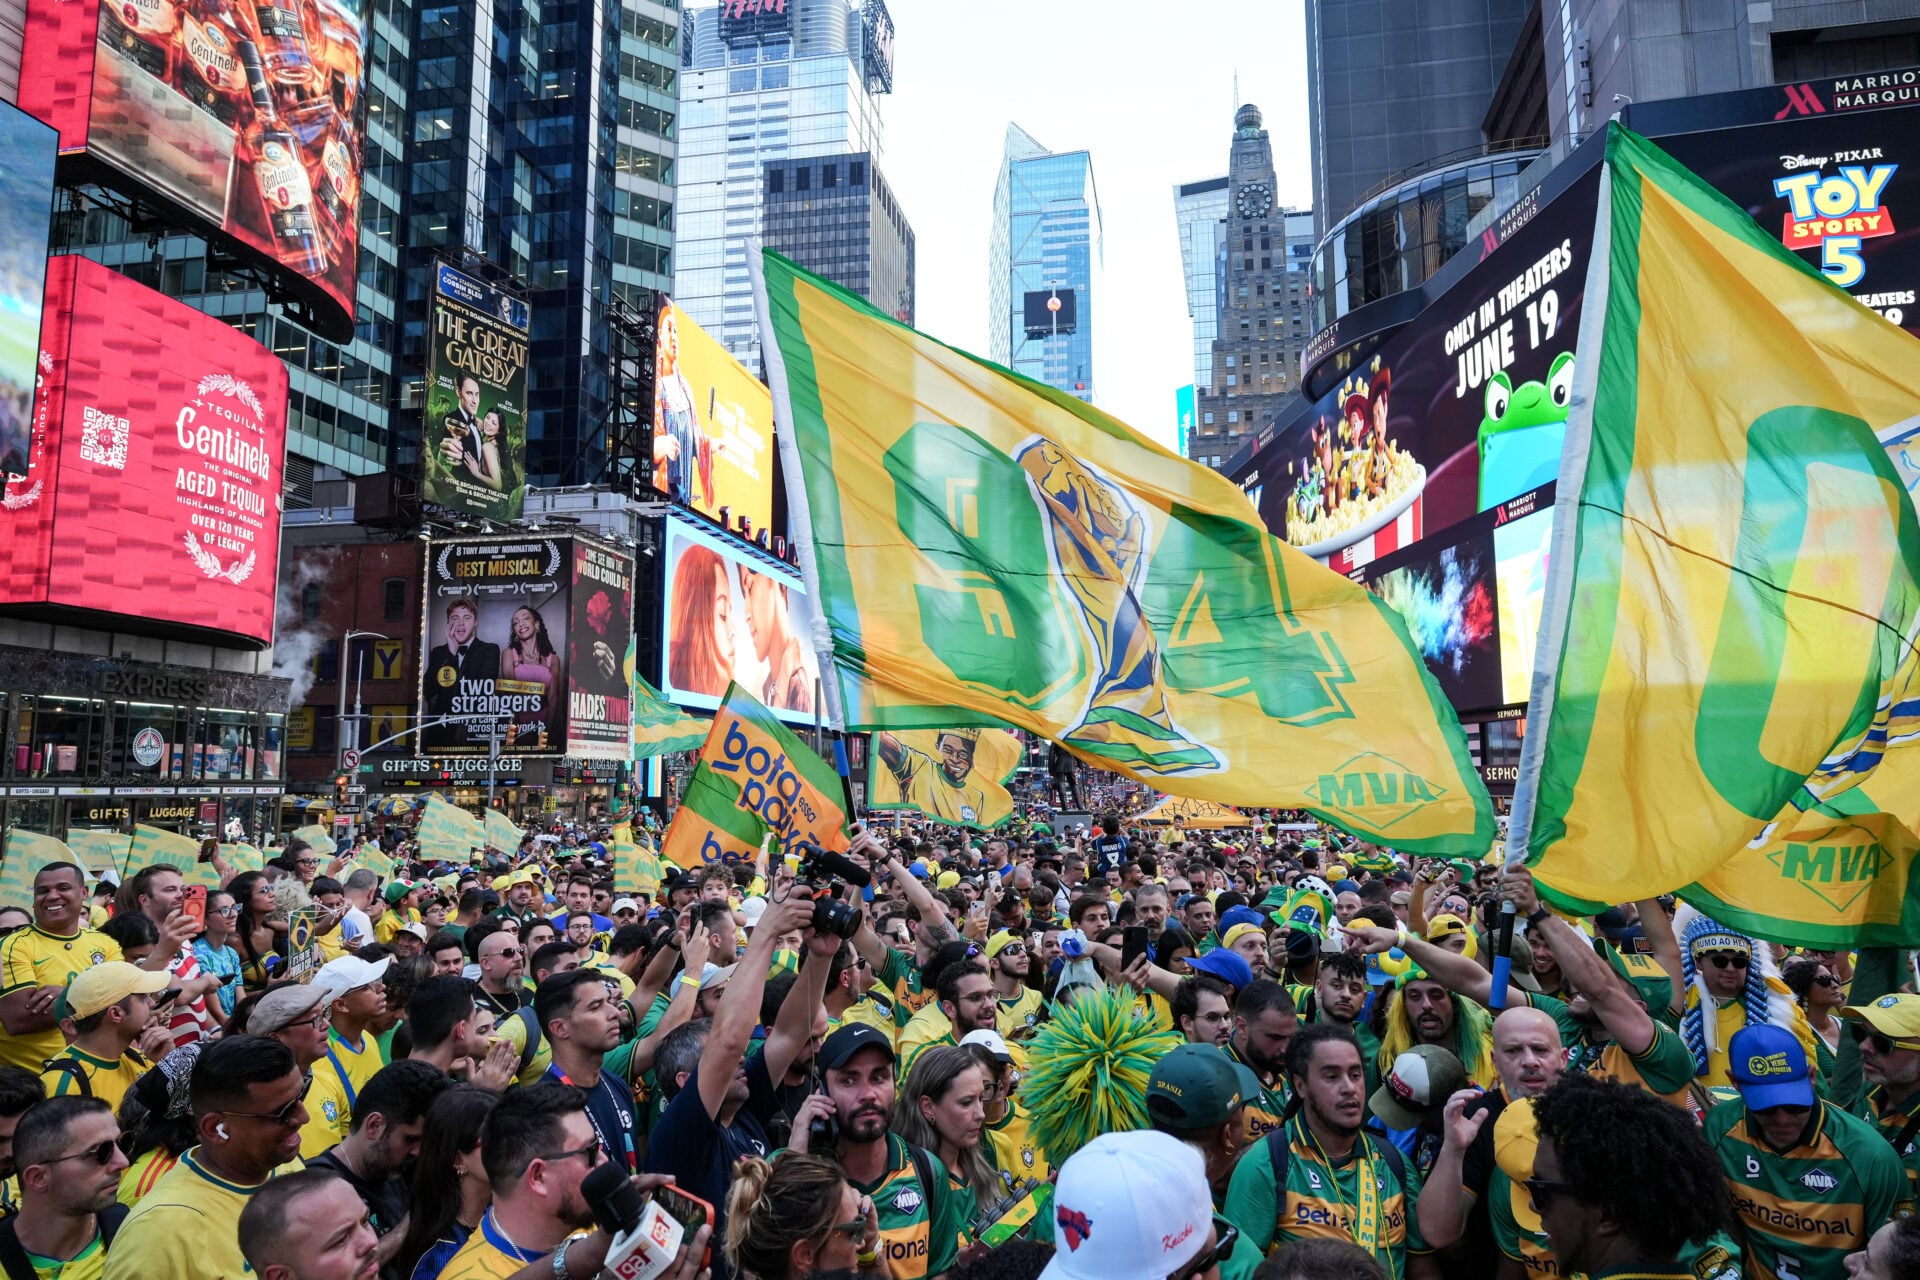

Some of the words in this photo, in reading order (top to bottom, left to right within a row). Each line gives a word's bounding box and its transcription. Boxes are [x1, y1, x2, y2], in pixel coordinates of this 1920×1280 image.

[191, 37, 238, 72] Centinela
[1835, 71, 1920, 92] MARRIO
[1836, 87, 1919, 108] MARQUI
[1835, 147, 1883, 163] PIXAR
[262, 164, 299, 194] Centinela
[1500, 184, 1541, 228] MARRIOTT
[1773, 164, 1898, 222] TOY
[1501, 204, 1537, 241] MARQUIS
[1793, 215, 1882, 238] STORY
[1821, 235, 1866, 288] 5
[442, 276, 466, 292] CORBIN
[467, 288, 482, 300] BLEU
[1444, 311, 1476, 356] ONLY
[1480, 297, 1496, 332] IN
[1498, 238, 1572, 316] THEATERS
[435, 295, 447, 306] THE
[447, 301, 469, 315] PARTY'S
[469, 311, 493, 327] ROARING
[493, 322, 501, 330] ON
[502, 325, 529, 342] BROADWAY
[437, 306, 468, 344] THE
[471, 326, 527, 368] GREAT
[1308, 322, 1340, 352] MARRIOTT
[1308, 337, 1335, 364] MARQUIS
[1456, 318, 1515, 398] JUNE
[1526, 289, 1559, 350] 19
[445, 341, 517, 386] GATSBY
[207, 402, 257, 432] TEQUILA
[176, 406, 270, 481] Centinela
[204, 461, 220, 473] THE
[222, 468, 253, 486] ORIGINAL
[175, 467, 217, 498] AGED
[222, 481, 265, 518] TEQUILA
[1508, 491, 1537, 510] MARRIOTT
[176, 495, 225, 515] HIGHLANDS
[227, 510, 237, 519] OF
[1509, 502, 1534, 519] MARQUIS
[191, 513, 216, 530] OVER
[218, 520, 232, 535] 120
[234, 525, 255, 543] YEARS
[204, 532, 215, 545] OF
[217, 535, 246, 554] LEGACY
[463, 546, 478, 555] TONY
[501, 543, 542, 553] NOMINATIONS
[456, 560, 486, 577] BEST
[488, 558, 541, 577] MUSICAL
[585, 548, 597, 563] COME
[597, 552, 606, 567] SEE
[576, 557, 600, 580] WORLD
[600, 567, 621, 589] COULD
[621, 575, 630, 592] BE
[376, 648, 400, 678] Y
[103, 671, 208, 700] EXPRESS
[460, 676, 494, 696] two
[451, 694, 541, 716] strangers
[570, 691, 629, 723] HADESTOWN
[1497, 709, 1522, 719] SEPHORA
[467, 723, 494, 733] acros
[382, 759, 430, 772] GIFTS
[443, 759, 522, 772] LUGGAGE
[561, 757, 583, 770] GIFTS
[588, 758, 618, 770] LUGGAGE
[723, 719, 802, 806] bota
[1486, 766, 1519, 781] SEPHO
[1317, 772, 1440, 808] MVA
[89, 808, 130, 820] GIFTS
[150, 807, 196, 818] LUGGAGE
[799, 796, 817, 823] essa
[1781, 842, 1882, 884] MVA
[1719, 937, 1730, 946] AO
[1157, 1080, 1182, 1097] BRASIL
[1364, 1160, 1373, 1227] ATERIA
[1804, 1174, 1834, 1188] MVA
[897, 1191, 920, 1209] MVA
[1162, 1222, 1193, 1254] Knicks
